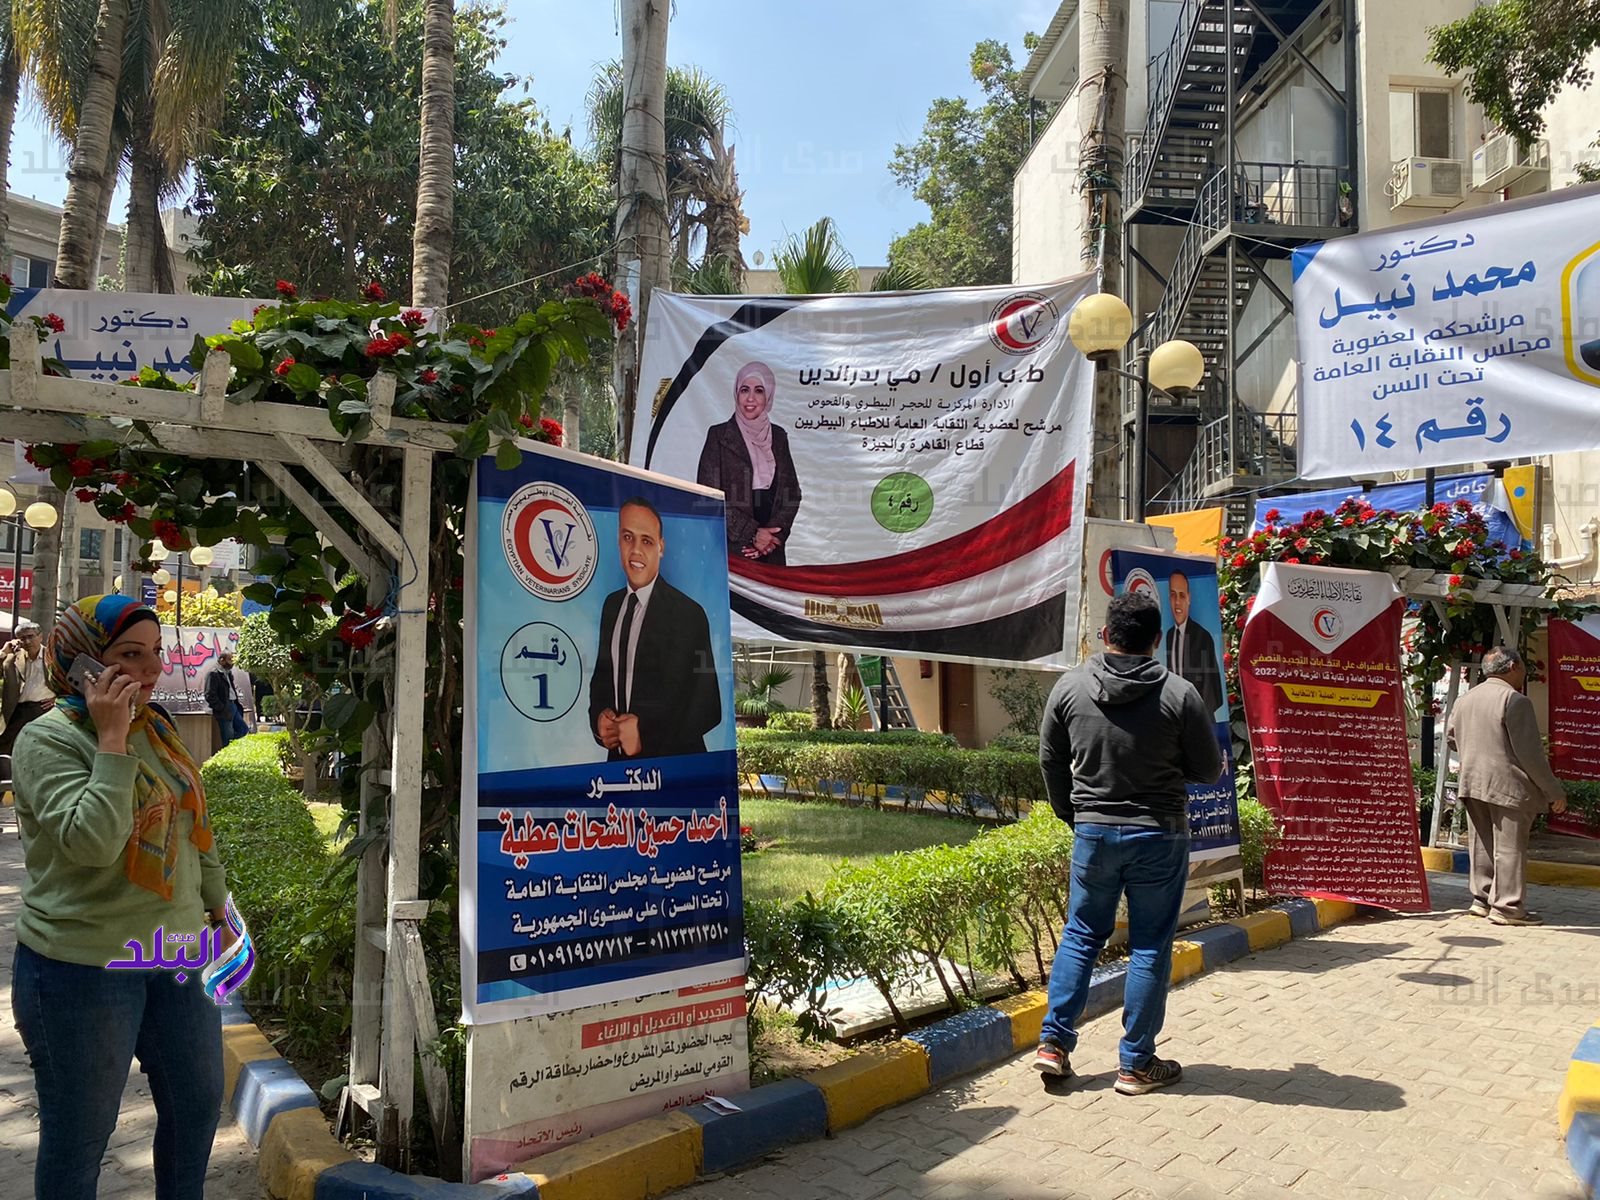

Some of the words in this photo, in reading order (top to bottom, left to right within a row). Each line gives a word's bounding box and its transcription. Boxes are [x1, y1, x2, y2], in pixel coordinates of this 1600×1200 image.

[1370, 233, 1475, 271] دكتور
[1432, 260, 1537, 300] محمد
[1319, 273, 1415, 328] نبيل
[90, 310, 188, 332] دكتور
[1424, 312, 1524, 344] مرشحكم
[1332, 328, 1415, 357] لعضوية
[1472, 337, 1550, 363] مجلس
[1313, 356, 1380, 382] العامة
[1389, 346, 1463, 372] النقابة
[887, 368, 921, 391] مي
[930, 363, 942, 384] /
[950, 359, 990, 388] أول
[1438, 367, 1483, 386] تحت
[1372, 373, 1428, 400] السن
[855, 397, 895, 411] البيطري
[900, 398, 931, 410] للحجر
[937, 398, 976, 410] المركزية
[982, 397, 1014, 409] الادارة
[795, 417, 845, 430] البيطريين
[850, 417, 890, 431] للاطباء
[893, 417, 928, 431] العامة
[932, 417, 967, 431] النقابة
[973, 418, 1019, 434] لعضوية
[1023, 420, 1062, 436] مرشح
[1351, 412, 1397, 452] ١٤
[1416, 397, 1511, 453] رقم
[862, 437, 906, 452] والجيزة
[909, 438, 950, 452] القاهرة
[955, 437, 984, 455] قطاع
[899, 493, 919, 513] رقم
[506, 538, 525, 576] EGYPTIAN
[525, 575, 571, 596] VETERINARIANS
[572, 554, 593, 588] SYNDICATE
[514, 637, 567, 666] رقم
[1255, 667, 1276, 676] 2022
[532, 673, 555, 710] 1
[586, 768, 662, 798] الدكتور
[1216, 786, 1232, 802] مرشح
[562, 802, 636, 853] الشحات
[686, 796, 728, 843] أحمد
[498, 808, 561, 869] عطية
[636, 807, 684, 858] حسين
[609, 872, 647, 895] مجلس
[649, 866, 696, 889] لعضوية
[697, 860, 731, 886] مرشح
[504, 879, 551, 900] العامة
[555, 873, 607, 900] النقابة
[590, 904, 633, 928] مستوى
[635, 901, 658, 922] على
[512, 908, 587, 939] الجمهورية
[645, 1011, 684, 1034] التعديل
[686, 1005, 696, 1028] أو
[698, 1002, 733, 1024] التجديد
[632, 1016, 643, 1037] أو
[658, 1041, 675, 1058] لمقر
[674, 1033, 712, 1055] الحضور
[712, 1032, 733, 1045] يجب
[622, 1045, 658, 1067] المشروع
[703, 1055, 733, 1078] القومي
[546, 1063, 582, 1077] بطاقة
[674, 1062, 703, 1083] للعضو
[510, 1070, 544, 1093] الرقم
[629, 1070, 663, 1093] المريض
[662, 1096, 685, 1111] العام
[517, 1129, 555, 1149] الاتحاد
[557, 1122, 582, 1142] رئيس
